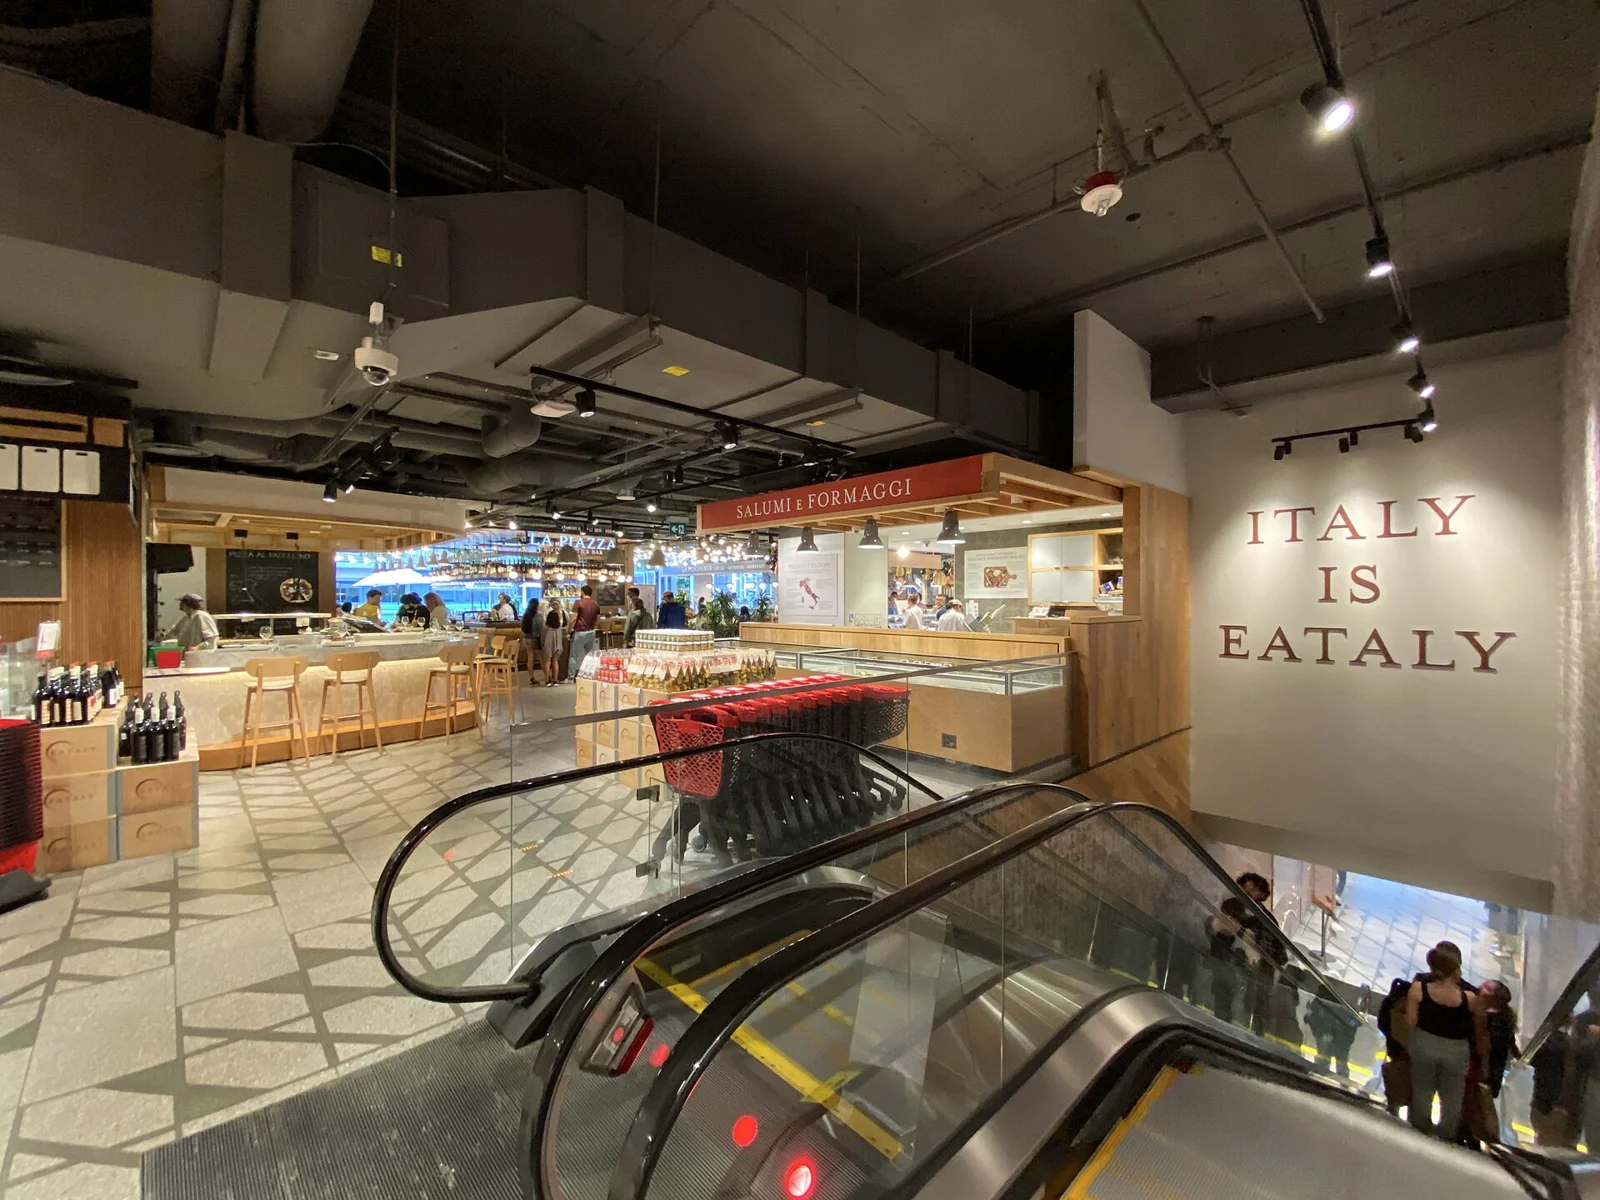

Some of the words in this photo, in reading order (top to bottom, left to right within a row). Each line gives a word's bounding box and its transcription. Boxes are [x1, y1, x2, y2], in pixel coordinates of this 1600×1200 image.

[736, 497, 791, 519] SALUMI
[796, 499, 803, 511] E
[807, 478, 912, 509] FORMAGGI
[1247, 495, 1476, 544] ITALY
[529, 533, 552, 546] LA
[560, 535, 616, 550] PIAZZA
[1318, 564, 1380, 604] IS
[1218, 624, 1517, 674] EATALY
